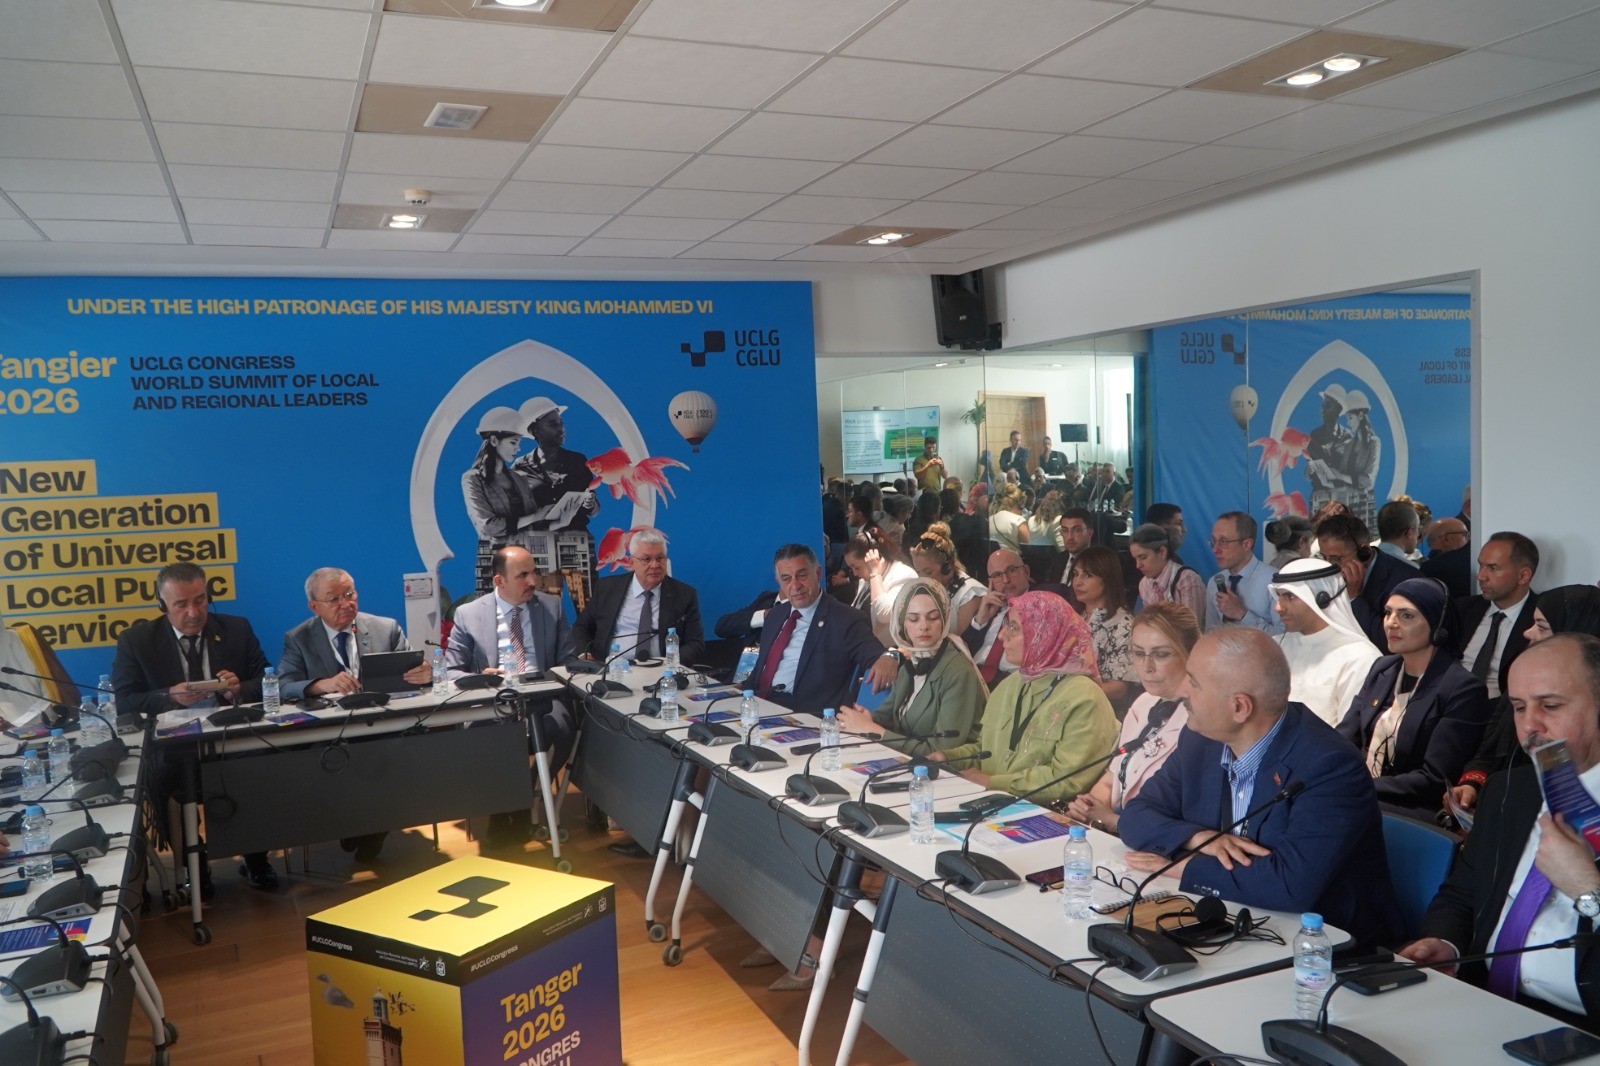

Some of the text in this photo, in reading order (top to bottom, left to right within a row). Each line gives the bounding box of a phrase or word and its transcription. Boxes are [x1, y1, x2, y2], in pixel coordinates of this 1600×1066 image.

[67, 299, 713, 315] UNDER THE HIGH PATRONAGE OF HIS MAJESTY KING MOHAMMED VI
[734, 329, 780, 347] UCLG
[0, 350, 117, 384] angier
[129, 356, 295, 371] UCLG CONGRESS
[736, 349, 781, 367] CGLU
[130, 373, 379, 390] WORLD SUMMIT OF LOCAL
[132, 392, 368, 410] AND REGIONAL LEADERS
[0, 468, 86, 494] New
[1, 498, 210, 533] Generation
[3, 533, 226, 572] of Universal
[7, 576, 228, 609] Local Puc
[11, 614, 148, 645] ervic
[471, 944, 519, 972] #UCLGCongress
[500, 962, 583, 1023] Tanger
[503, 1003, 566, 1061] 2026
